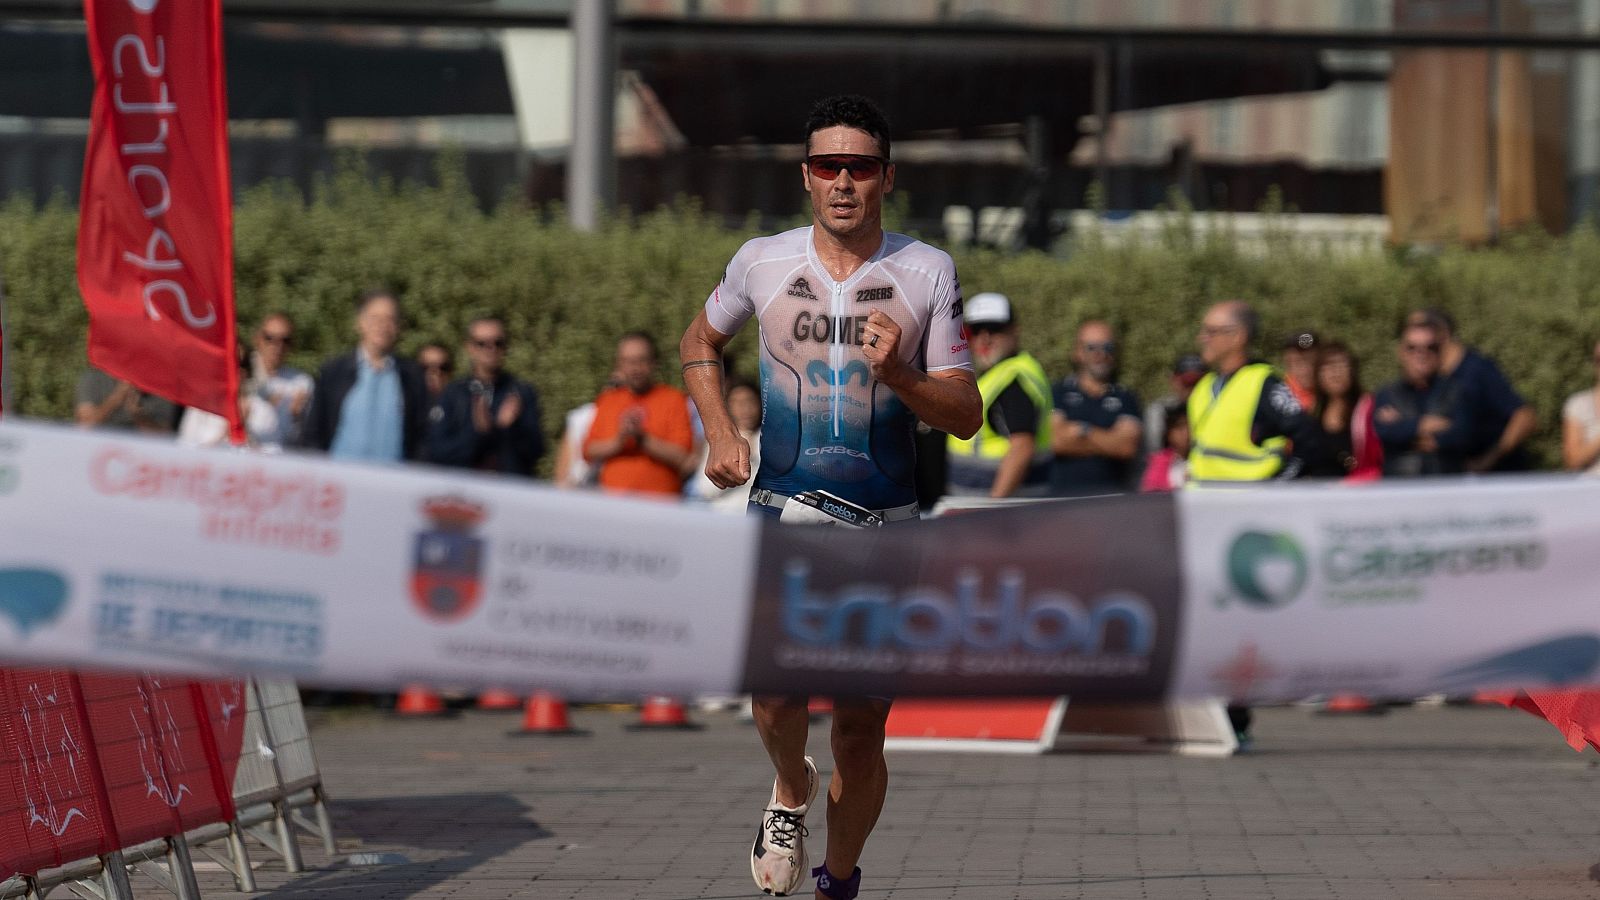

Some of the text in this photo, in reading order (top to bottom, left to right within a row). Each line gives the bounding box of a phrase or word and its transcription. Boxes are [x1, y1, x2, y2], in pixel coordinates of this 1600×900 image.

[856, 287, 893, 302] 226ERS
[793, 310, 868, 347] GOME
[804, 445, 871, 461] ORBEA
